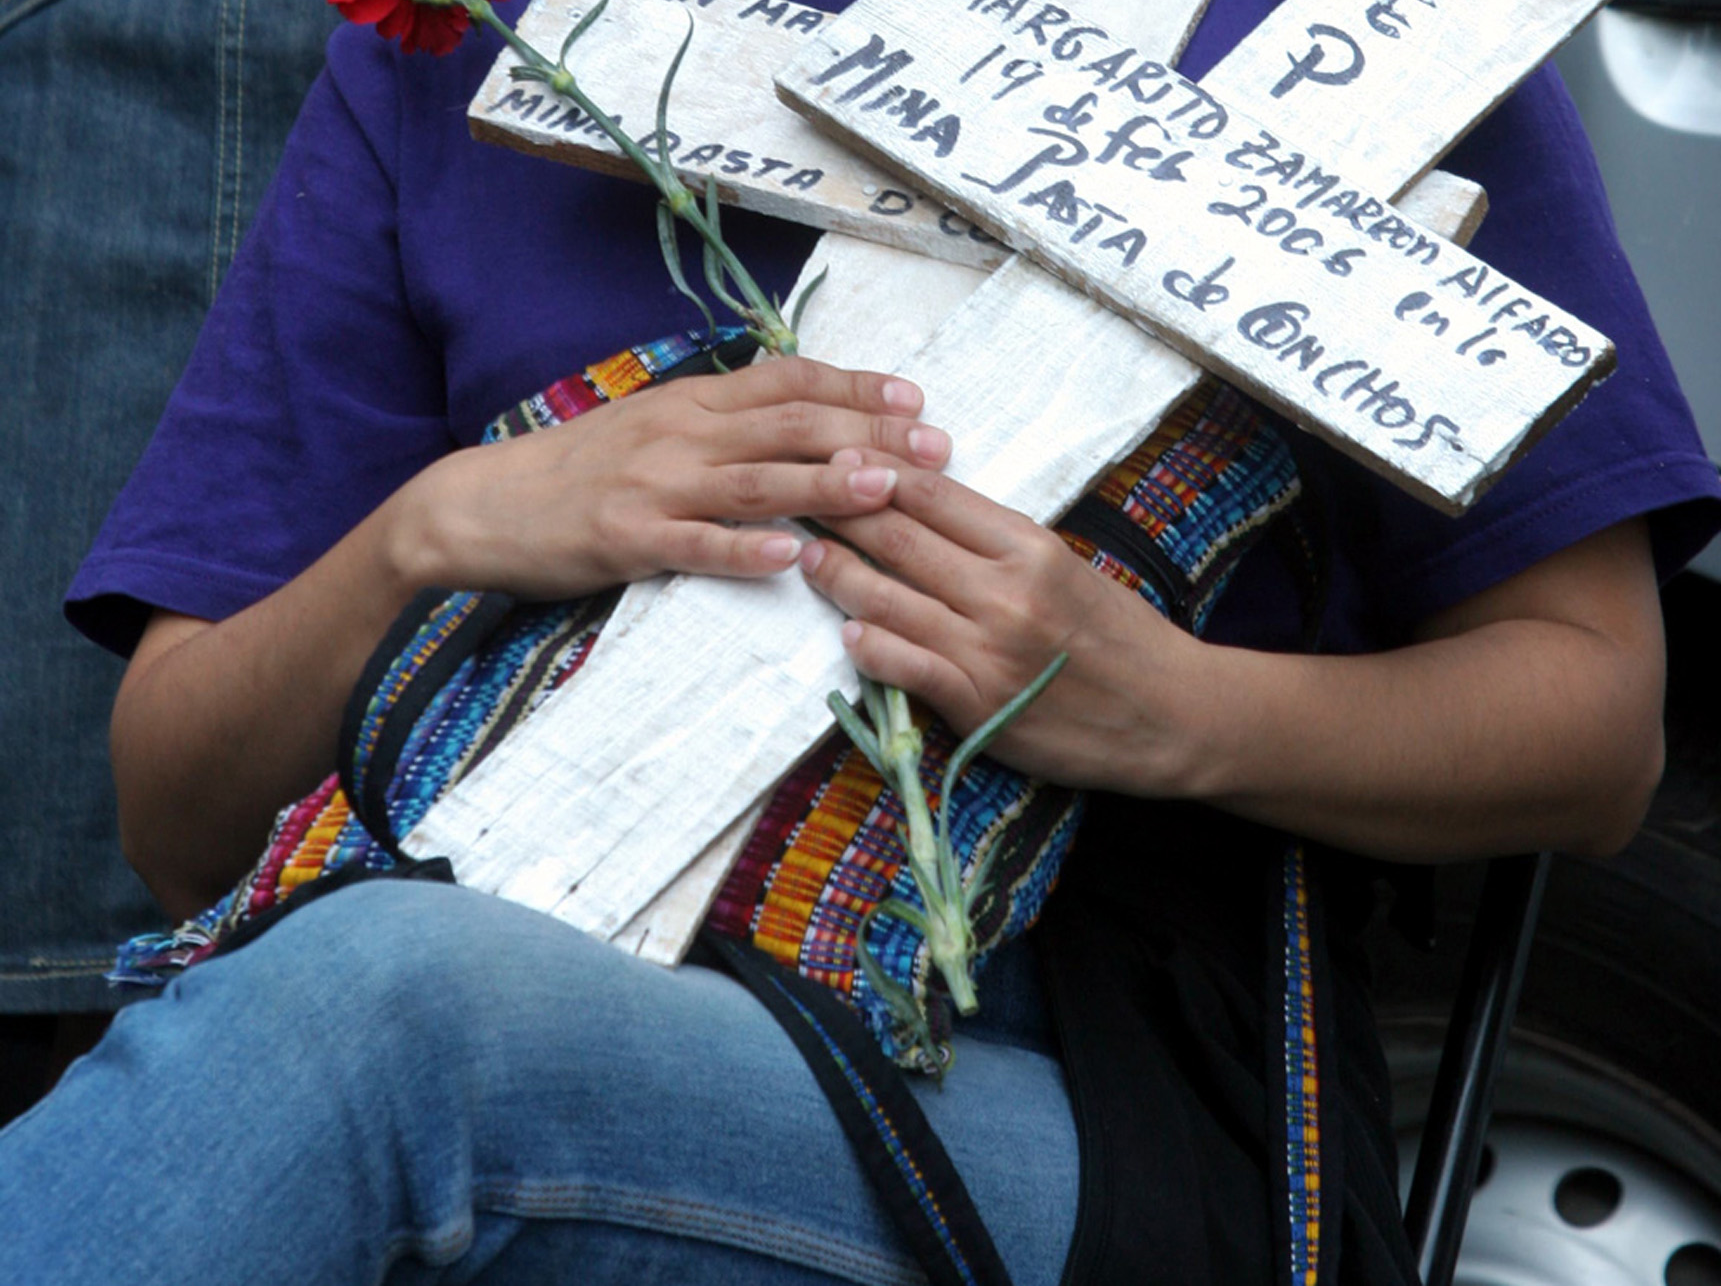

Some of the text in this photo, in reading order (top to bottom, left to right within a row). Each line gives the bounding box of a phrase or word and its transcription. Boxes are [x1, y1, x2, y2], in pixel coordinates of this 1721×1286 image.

[960, 45, 1044, 101] 19
[1206, 184, 1368, 277] 2006
[961, 127, 1148, 267] PASTA
[1236, 301, 1462, 451] CONCHOS
